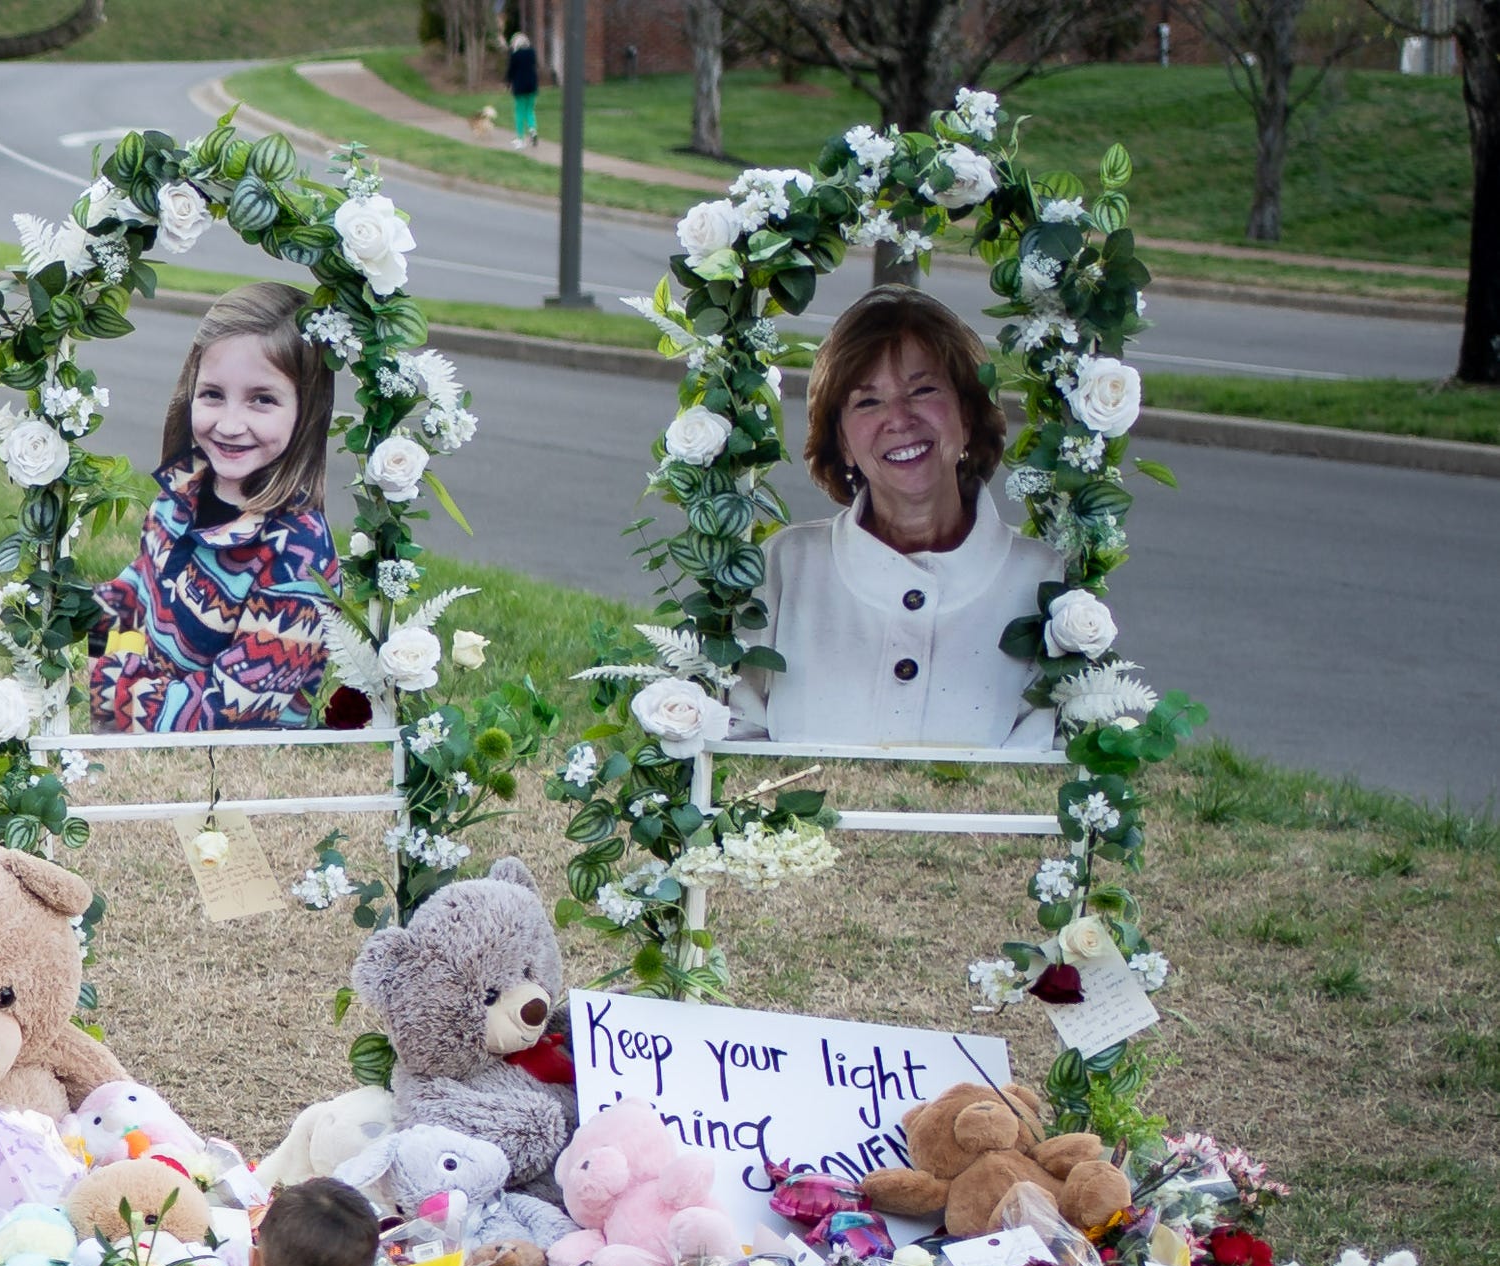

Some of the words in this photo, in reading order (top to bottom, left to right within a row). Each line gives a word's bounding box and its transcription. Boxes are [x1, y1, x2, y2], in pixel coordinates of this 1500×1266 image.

[586, 999, 673, 1096] Keep
[704, 1040, 787, 1102] your
[821, 1038, 927, 1129] light
[599, 1091, 777, 1192] ning
